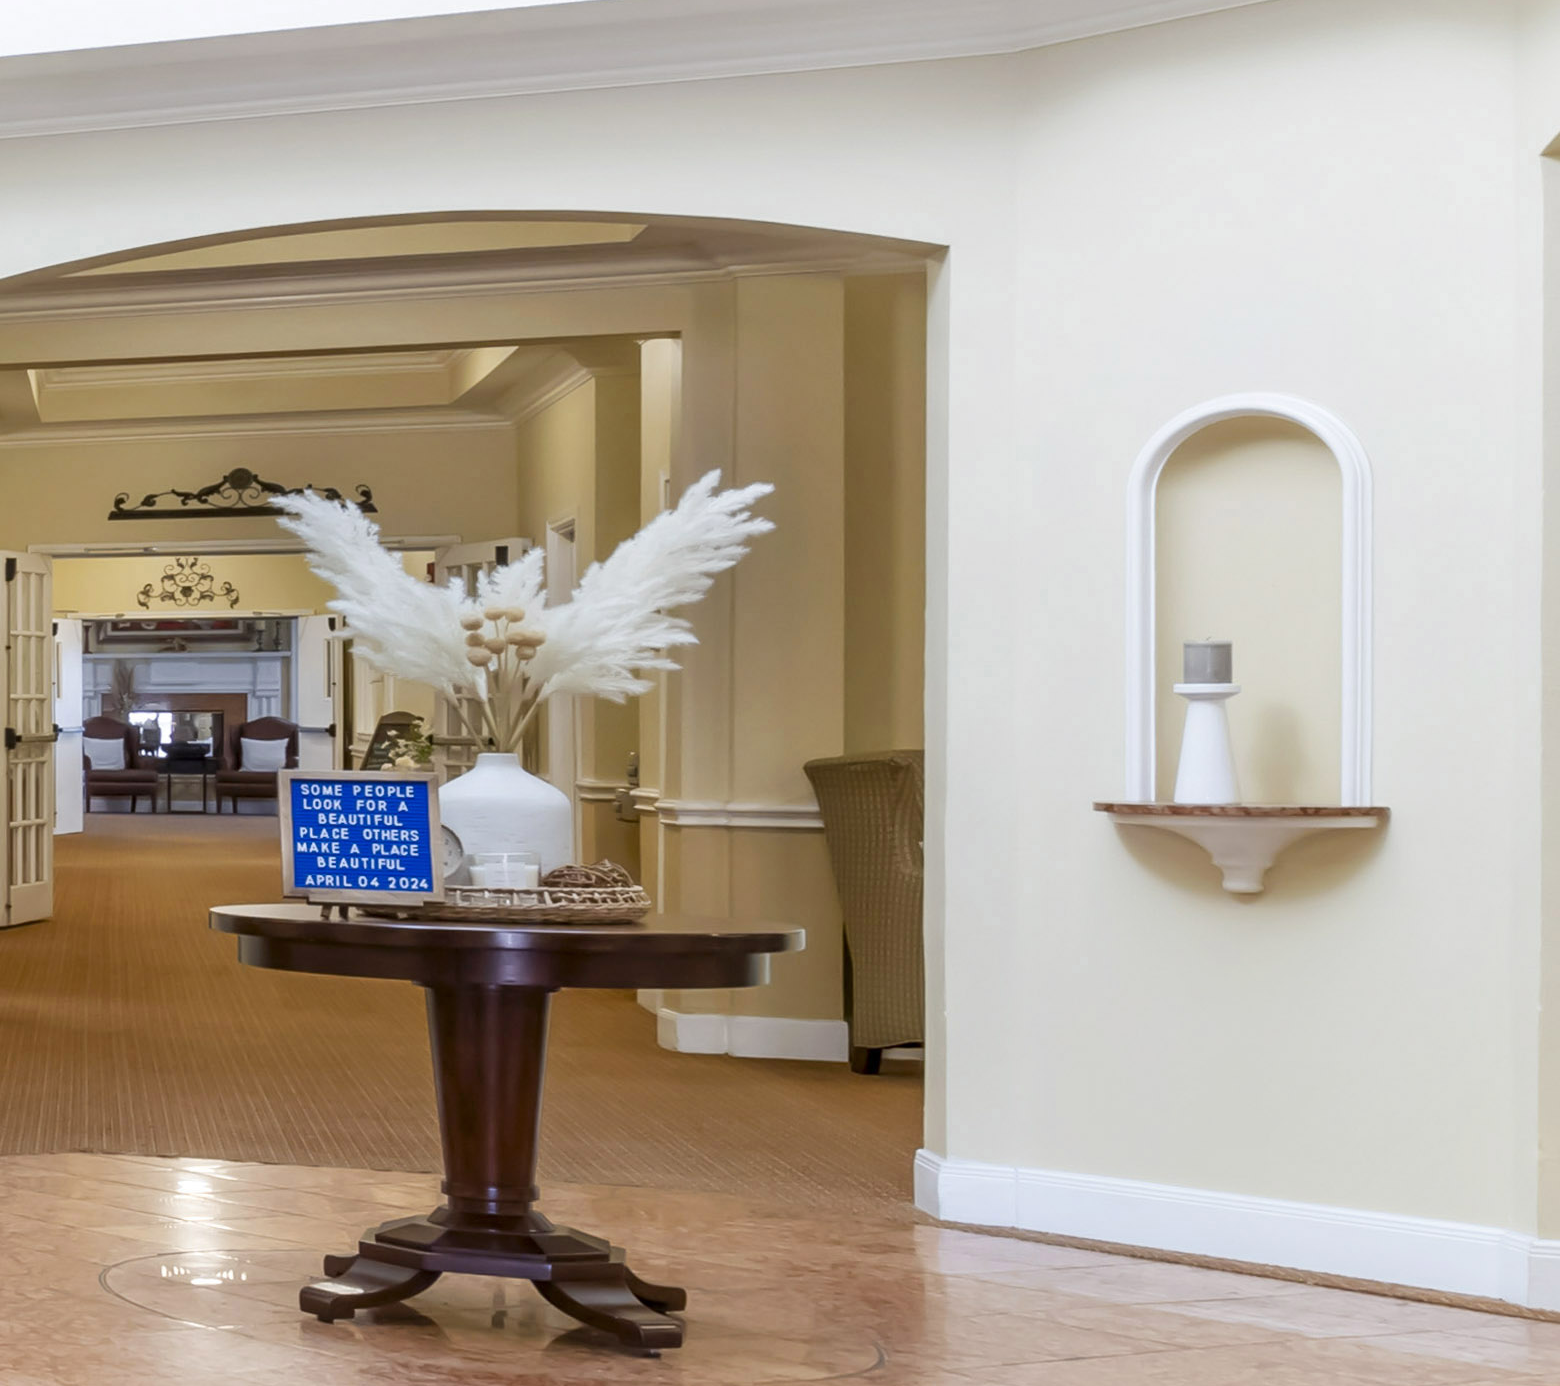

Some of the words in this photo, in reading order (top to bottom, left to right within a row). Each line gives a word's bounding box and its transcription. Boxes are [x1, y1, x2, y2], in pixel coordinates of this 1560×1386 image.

[300, 784, 343, 796] SOME
[353, 785, 414, 798] PEOPLE
[303, 799, 342, 810] LOOK
[356, 800, 387, 811] FOR
[398, 801, 408, 812] A
[318, 813, 403, 826] BEAUTIFUL
[299, 827, 349, 839] PLACE
[362, 828, 420, 841] OTHERS
[297, 842, 340, 854] MAKE
[350, 843, 360, 854] A
[372, 843, 419, 856] PLACE
[317, 856, 406, 871] BEAUTIFUL
[305, 874, 352, 887] APRIL
[358, 876, 379, 888] 04
[388, 877, 429, 890] 2024
